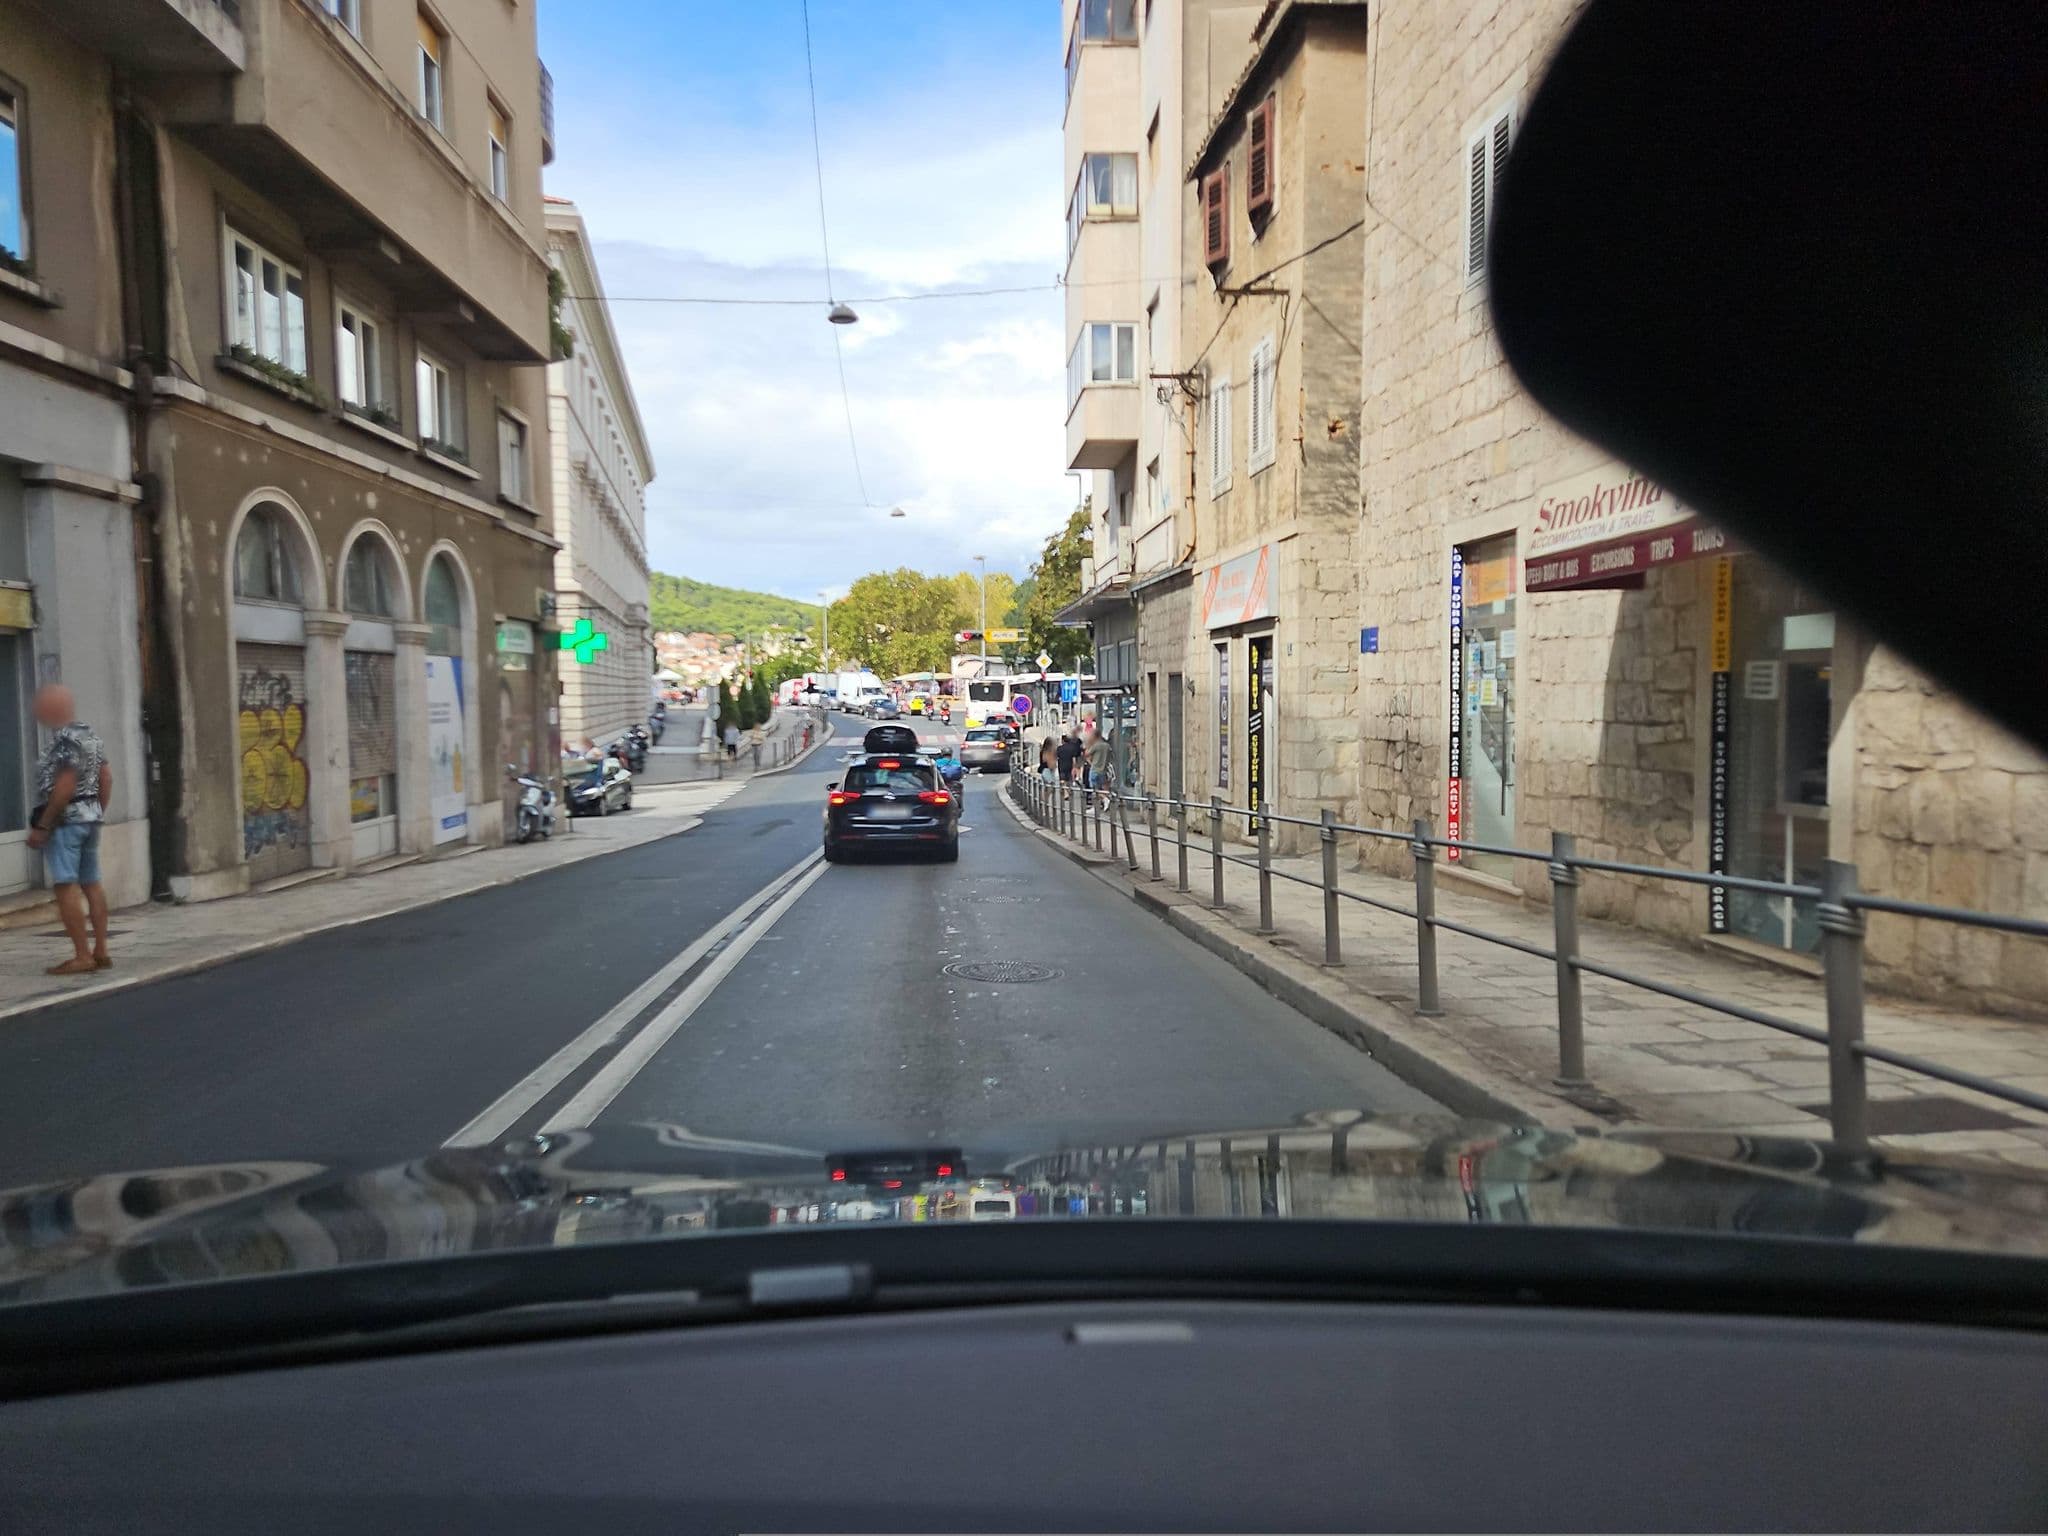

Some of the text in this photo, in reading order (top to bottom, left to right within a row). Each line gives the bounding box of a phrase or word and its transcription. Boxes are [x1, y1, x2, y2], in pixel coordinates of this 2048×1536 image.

[1534, 477, 1664, 533] Smokvina
[1617, 511, 1656, 531] TRAVEL
[1543, 562, 1559, 583] BOAT
[1566, 558, 1579, 577] BUS
[1591, 546, 1635, 573] EXCURSIONS
[1650, 537, 1675, 561] TRIPS
[1692, 528, 1725, 552] TOURS
[1451, 648, 1461, 691] STORAGE
[1451, 691, 1460, 732] LUGGAGE
[1451, 737, 1460, 778] STORAGE
[1449, 780, 1459, 815] PARTY
[1713, 674, 1727, 929] LUGGAGE STORAGE LUGGAGE SORAGE
